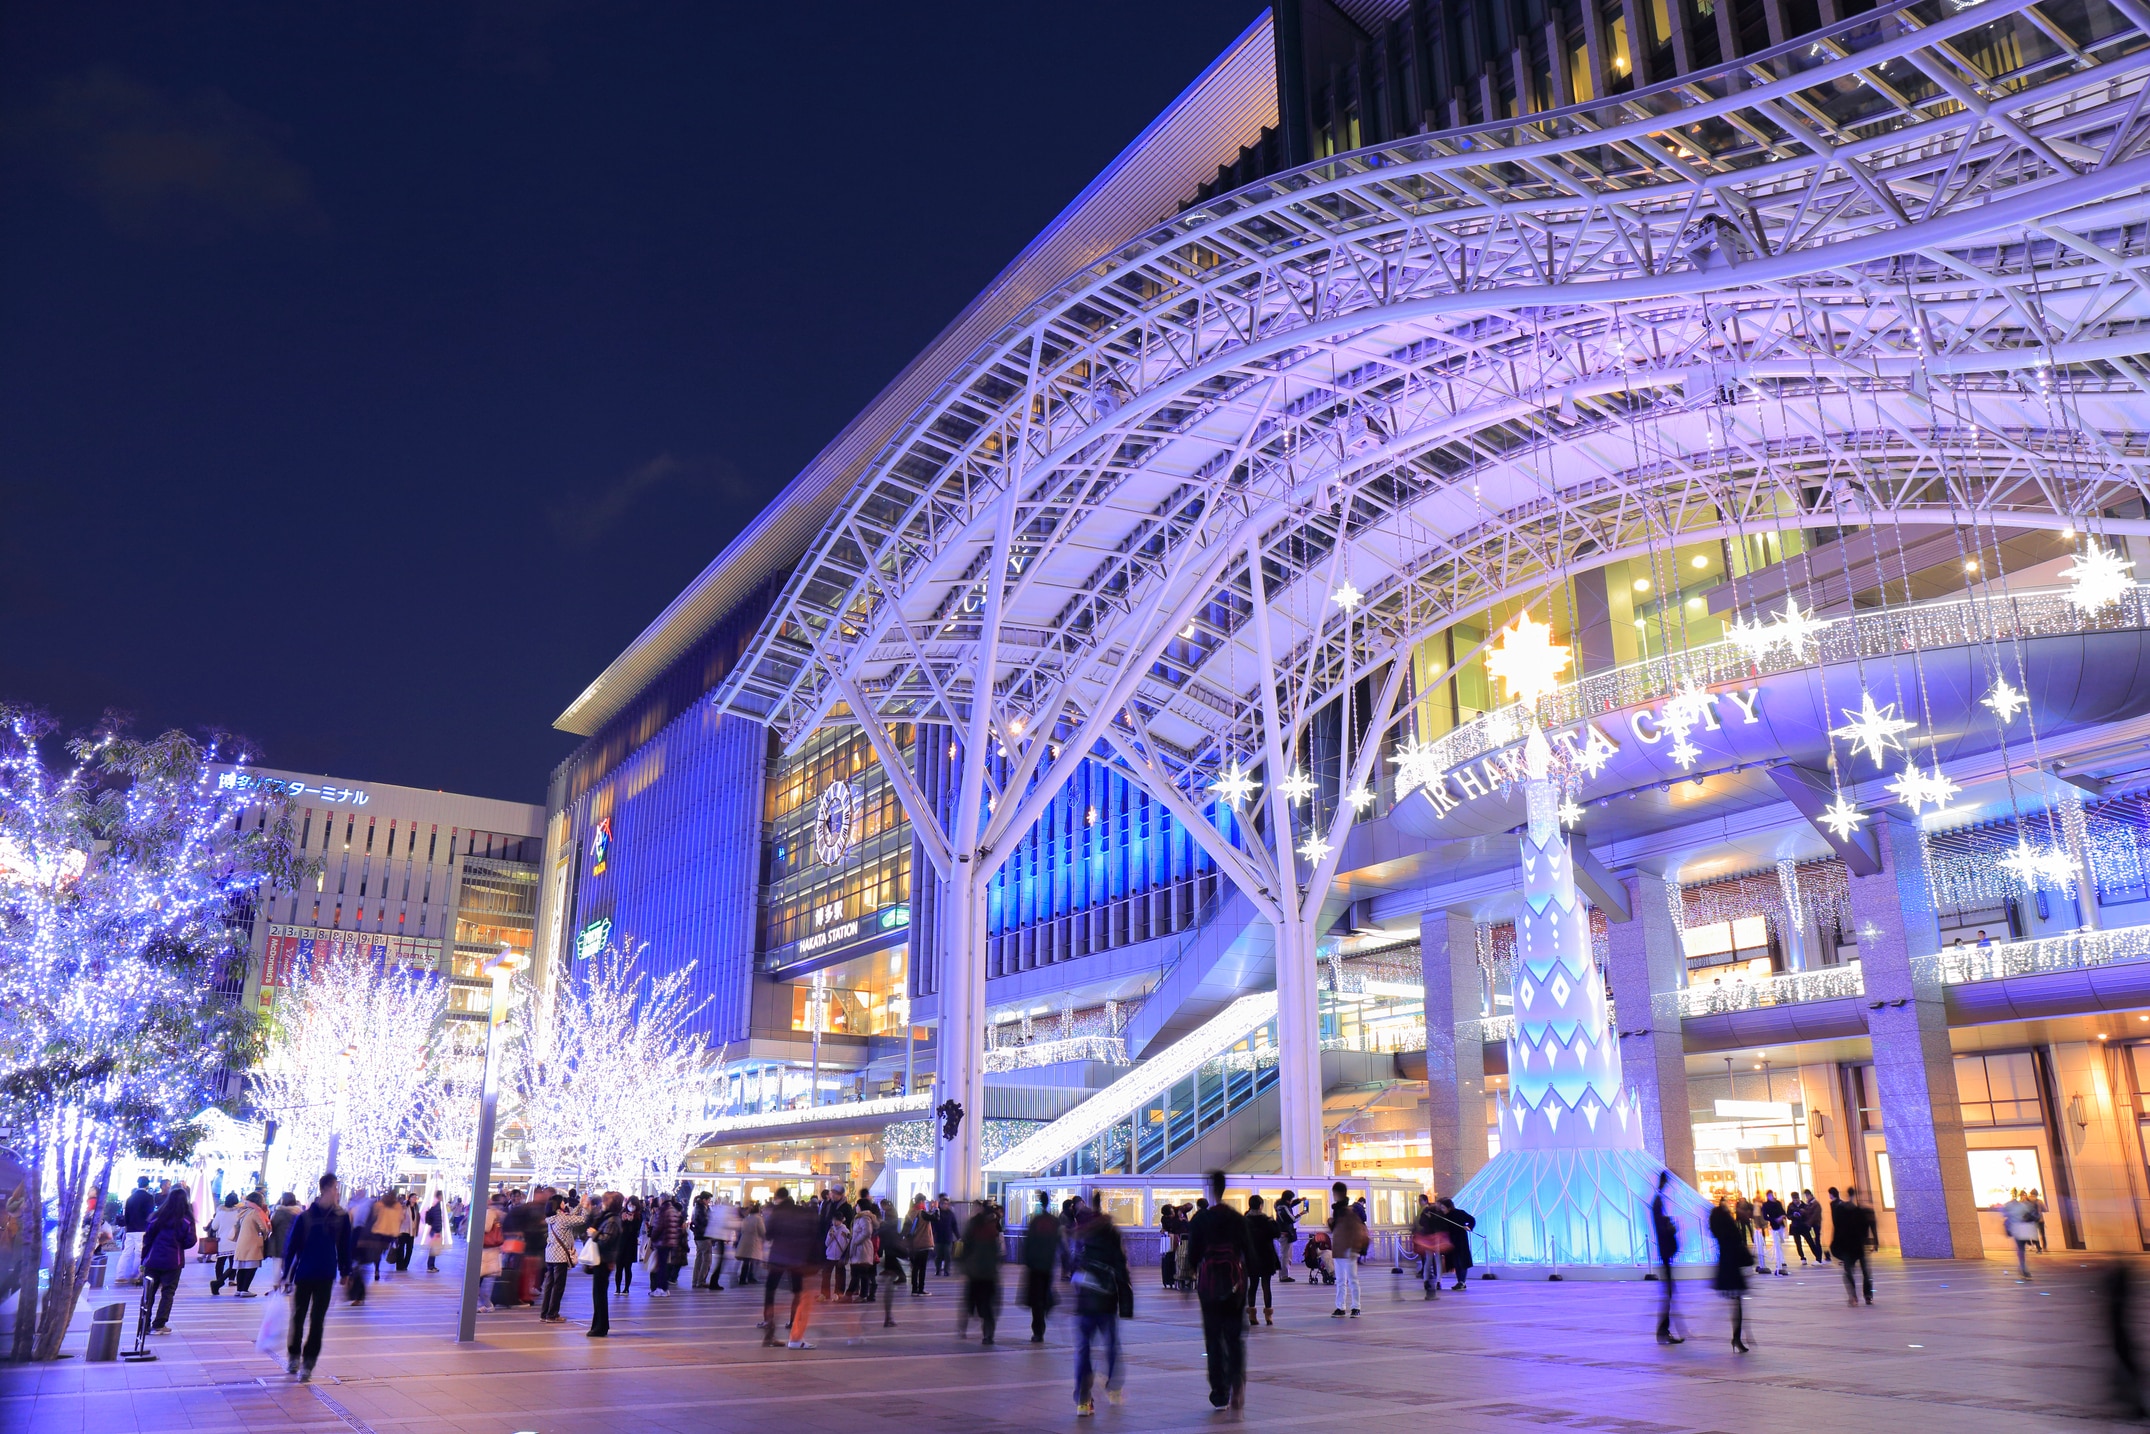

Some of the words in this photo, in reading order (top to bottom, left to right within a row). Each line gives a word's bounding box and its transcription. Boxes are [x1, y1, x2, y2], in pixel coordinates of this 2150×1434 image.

[1420, 783, 1462, 820] JR
[1452, 723, 1620, 801] HAKTA
[1631, 688, 1759, 744] CTY
[815, 900, 843, 928] 博多駅
[271, 926, 280, 936] 2F
[287, 927, 297, 936] 3F
[799, 933, 827, 954] HAKATA
[828, 920, 859, 944] STATION
[265, 938, 278, 984] McDonald's
